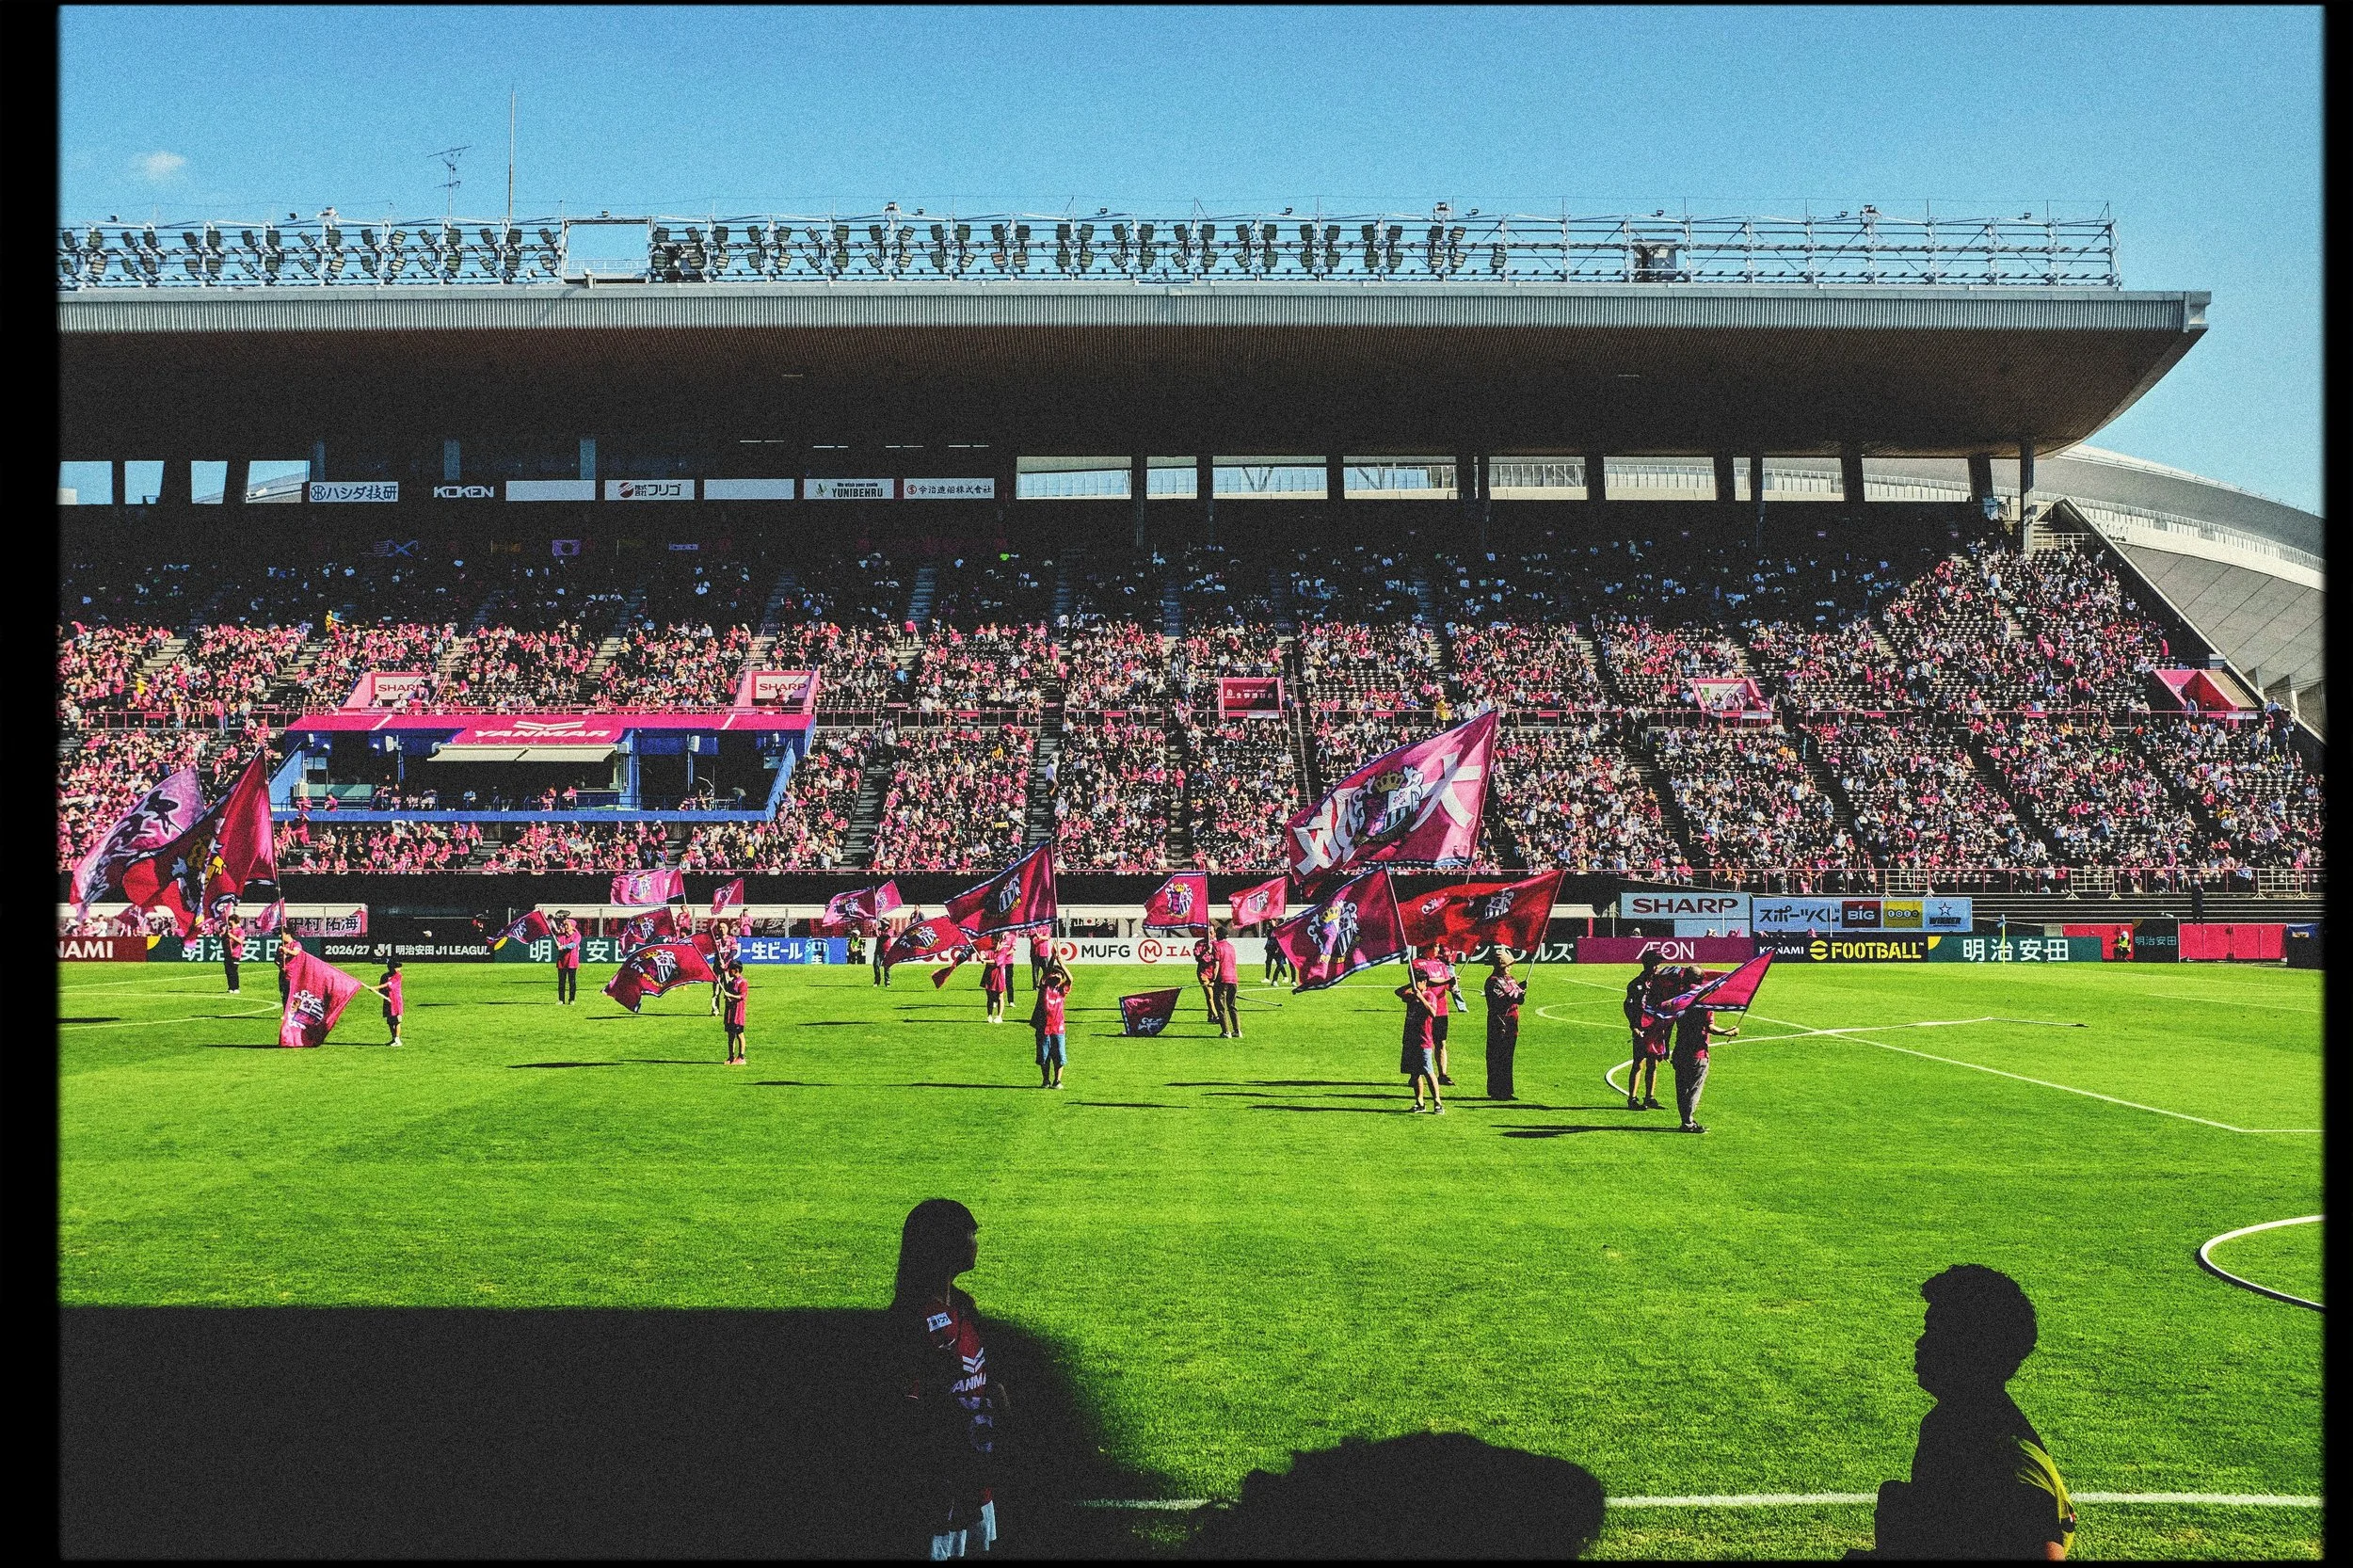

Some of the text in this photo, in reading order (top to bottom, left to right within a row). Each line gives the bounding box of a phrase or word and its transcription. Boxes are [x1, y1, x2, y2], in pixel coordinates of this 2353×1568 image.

[327, 486, 397, 500] ハシダ技研
[433, 486, 494, 498] KOKEN
[648, 484, 681, 496] フリゴ
[832, 488, 884, 498] YUNIBEHRU
[1632, 897, 1739, 914] SHARP
[1848, 905, 1876, 920] BIG
[1759, 905, 1840, 922] スポーツくじ
[2135, 936, 2177, 947] 明治安田
[325, 944, 370, 956] 2026/27
[395, 945, 435, 956] 明治安田
[436, 945, 448, 956] J1
[1081, 944, 1130, 958] MUFG
[1962, 937, 2069, 962] 明治安田
